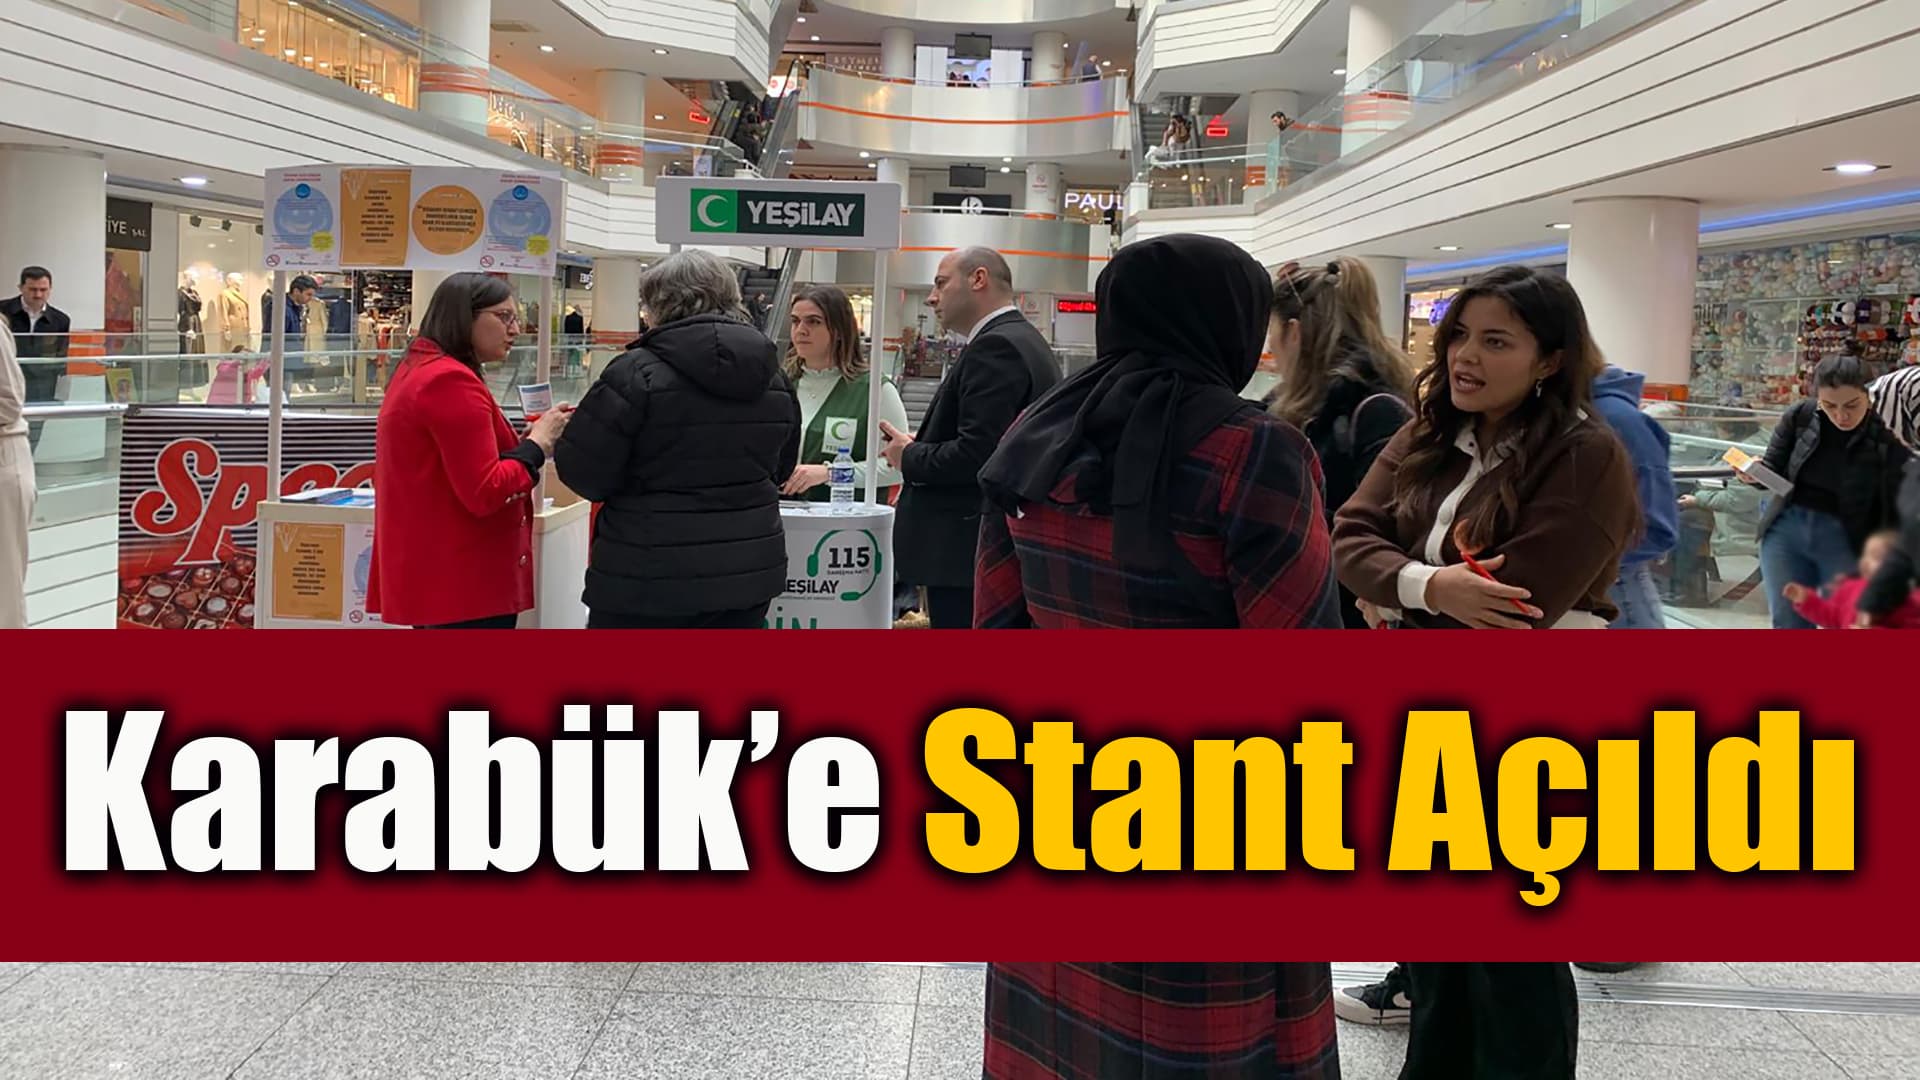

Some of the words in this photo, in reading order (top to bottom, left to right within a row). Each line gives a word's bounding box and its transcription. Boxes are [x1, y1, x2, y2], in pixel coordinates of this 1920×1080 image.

[1064, 193, 1124, 210] PAUL
[747, 200, 856, 228] YEŞİLAY
[107, 215, 127, 235] İYE
[828, 546, 870, 569] 115
[786, 579, 839, 595] EŞİLAY
